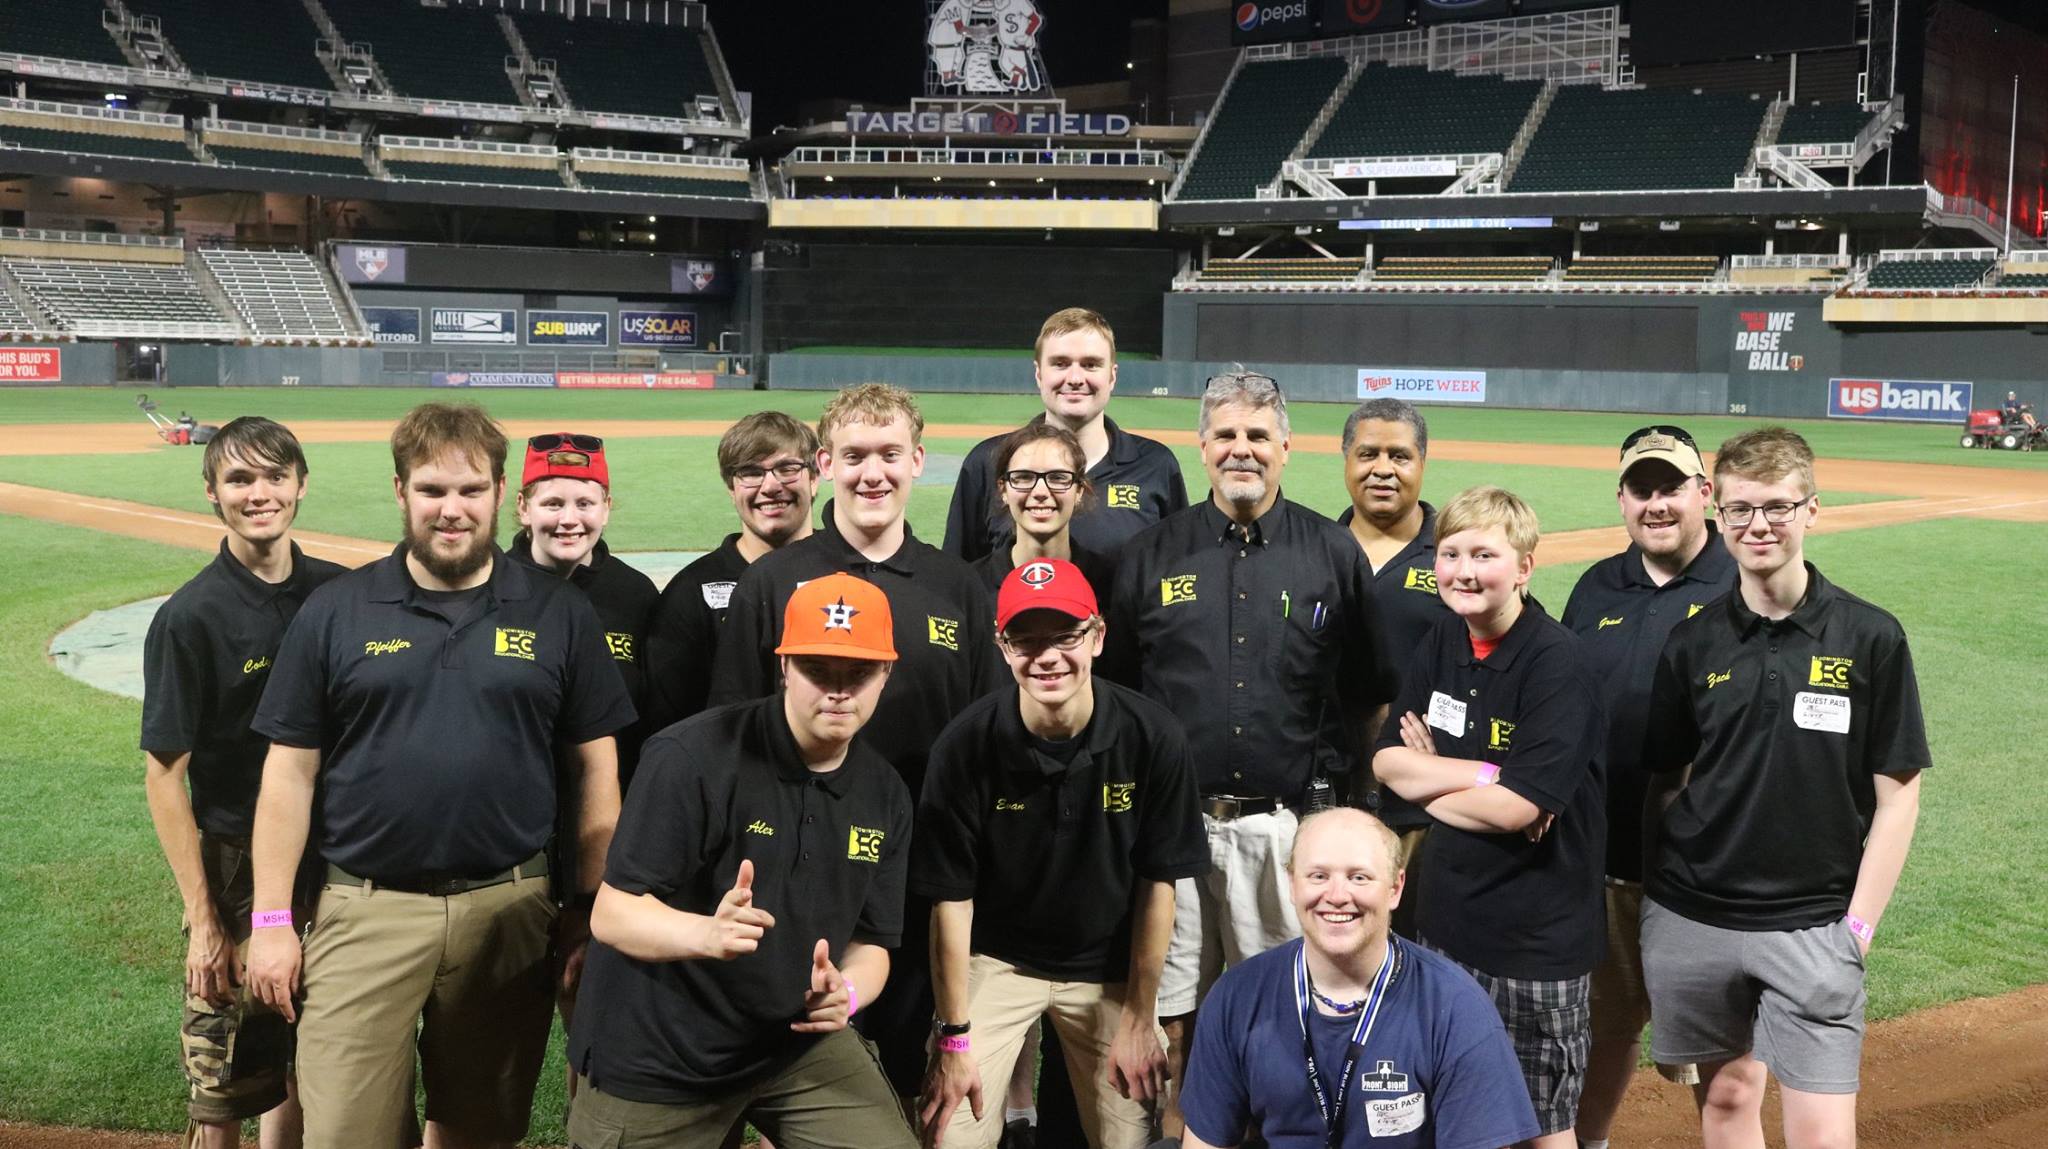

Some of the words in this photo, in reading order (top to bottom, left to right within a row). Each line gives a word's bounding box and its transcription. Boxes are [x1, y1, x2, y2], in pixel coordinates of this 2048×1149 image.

[1261, 0, 1306, 25] pepsi
[846, 112, 988, 133] TARGET
[1026, 113, 1130, 135] FIELD
[1437, 219, 1474, 228] ISLAND
[1480, 218, 1506, 228] COVE
[435, 311, 464, 326] ALTEC
[1768, 312, 1795, 331] WE
[534, 321, 602, 336] SUBWAY
[1735, 331, 1781, 351] BASE
[19, 352, 51, 364] BUD'S
[1748, 351, 1790, 371] BALL
[15, 365, 40, 376] YOU.
[281, 375, 300, 385] 377
[469, 375, 526, 384] COMMUNITY
[528, 375, 554, 384] FUND
[560, 375, 596, 385] GETTING
[597, 375, 623, 385] MORE
[657, 376, 672, 385] THE
[1395, 378, 1434, 391] HOPE
[1437, 380, 1480, 392] WEEK
[1152, 386, 1169, 396] 403
[1730, 403, 1746, 413] 365
[825, 604, 854, 629] H
[365, 639, 412, 656] Pfeiffer
[1707, 669, 1732, 689] Zach
[1802, 696, 1828, 705] GUEST
[1829, 698, 1847, 707] PASS
[746, 819, 774, 836] Alex
[1373, 1103, 1398, 1112] GUEST
[1401, 1093, 1422, 1109] PASS
